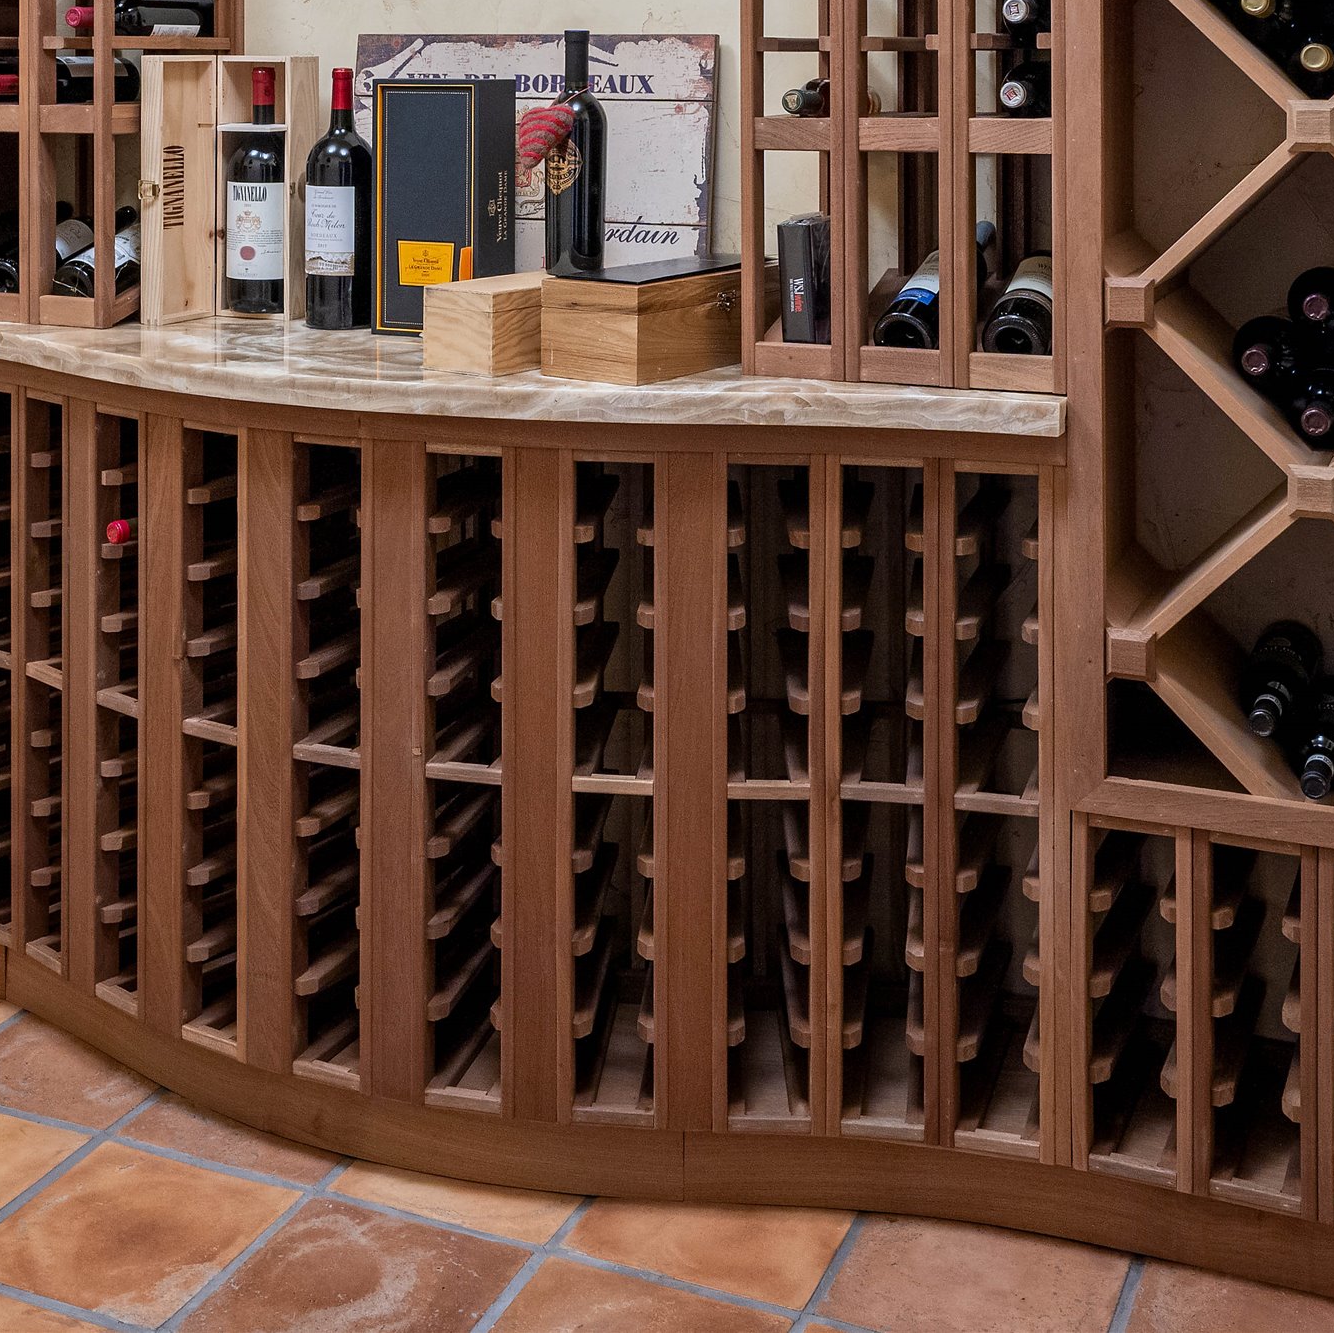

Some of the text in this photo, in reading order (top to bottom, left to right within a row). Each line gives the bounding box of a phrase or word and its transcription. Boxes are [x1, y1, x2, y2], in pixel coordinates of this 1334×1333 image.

[515, 74, 654, 94] BOREAUX
[163, 145, 184, 230] TIGNANELLO
[604, 216, 679, 244] rdain
